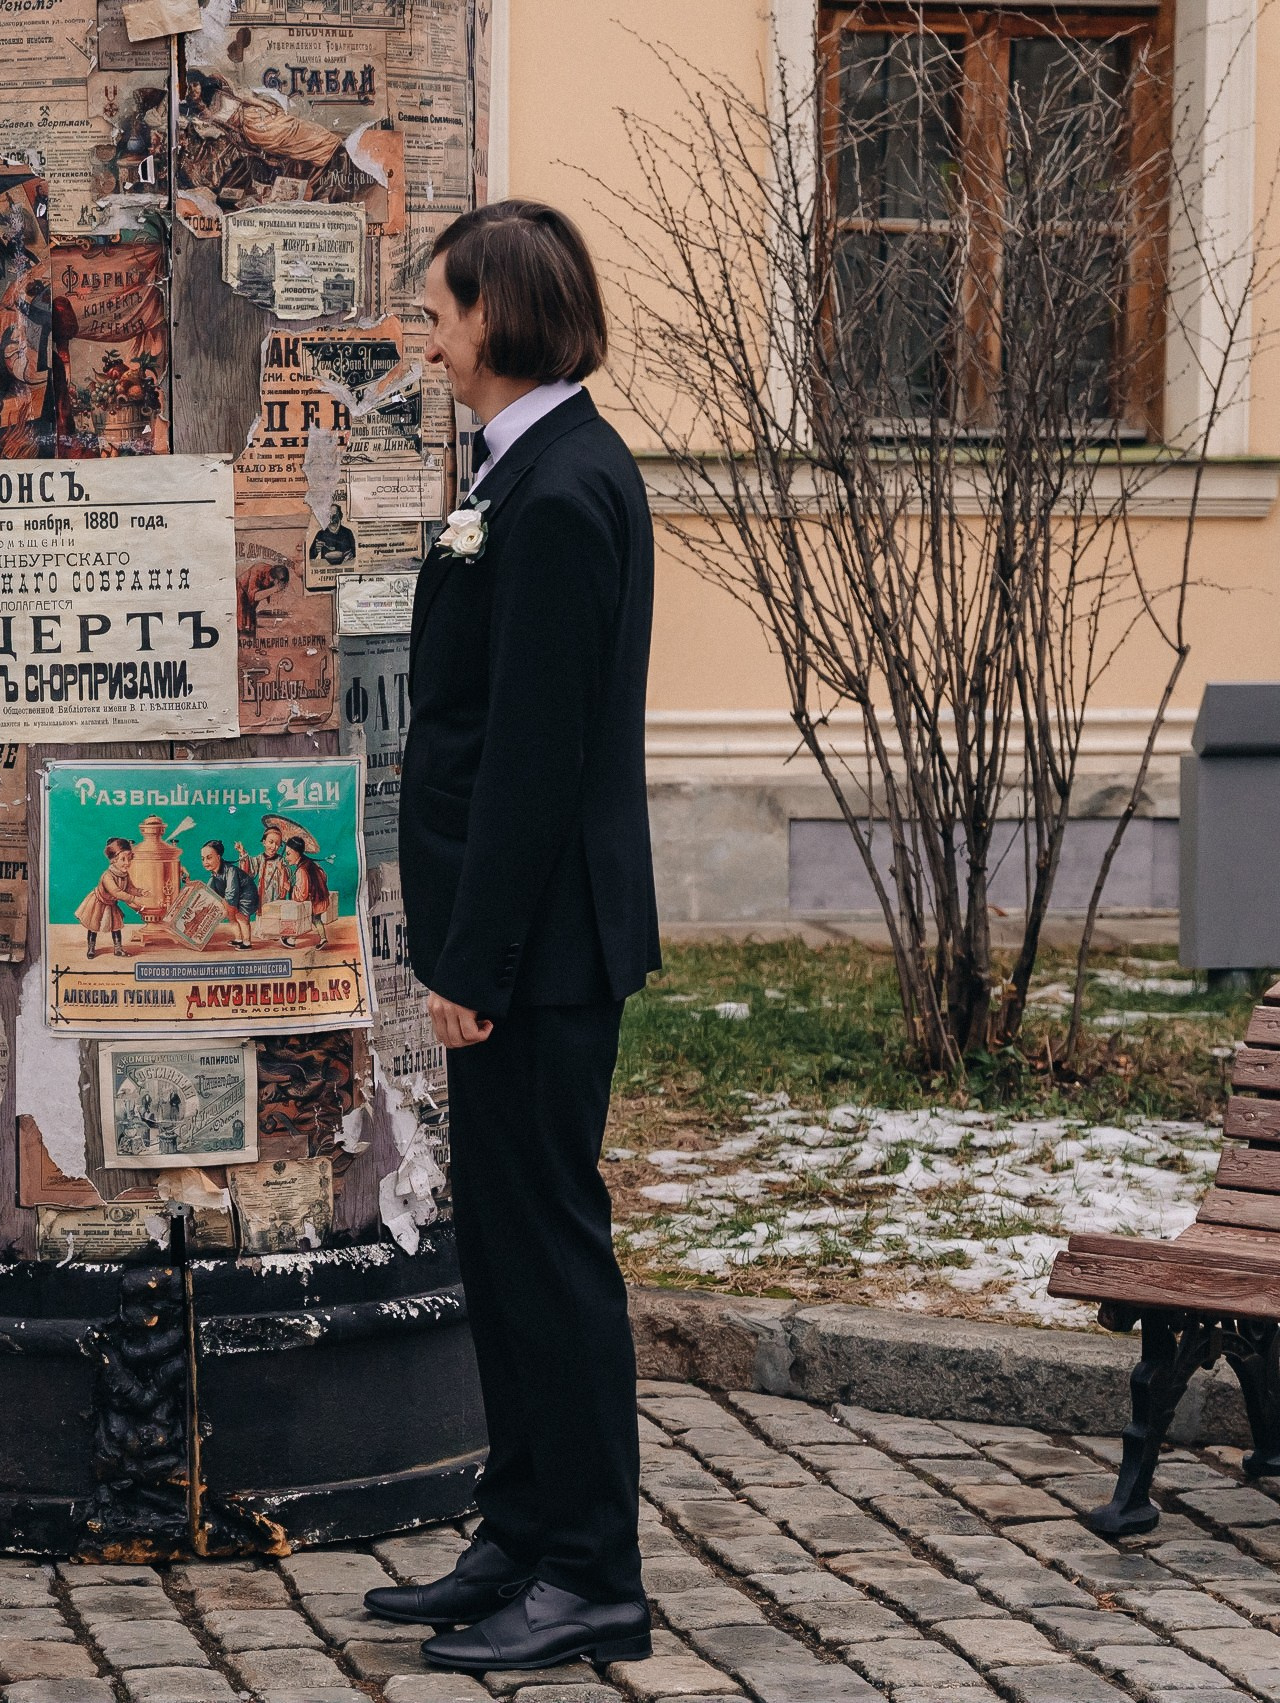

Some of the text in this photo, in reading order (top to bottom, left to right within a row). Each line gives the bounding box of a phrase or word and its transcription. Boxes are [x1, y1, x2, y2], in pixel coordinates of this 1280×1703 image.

[23, 513, 74, 536] ноября,
[83, 511, 119, 530] 1880
[130, 514, 168, 530] года,
[72, 568, 190, 593] СОБРАНІЯ
[291, 635, 326, 648] ФАБРИКИ
[25, 660, 194, 702] СЮРПРИЗАМИ,
[3, 705, 55, 715] Общественной
[58, 704, 101, 714] Библіотеки
[104, 705, 127, 713] имени
[140, 703, 148, 712] Г.
[236, 964, 288, 976] ТОВАРИЩЕСТВА
[123, 989, 177, 1007] ГУБКИНА
[200, 1054, 240, 1066] ПАПИРОСЫ
